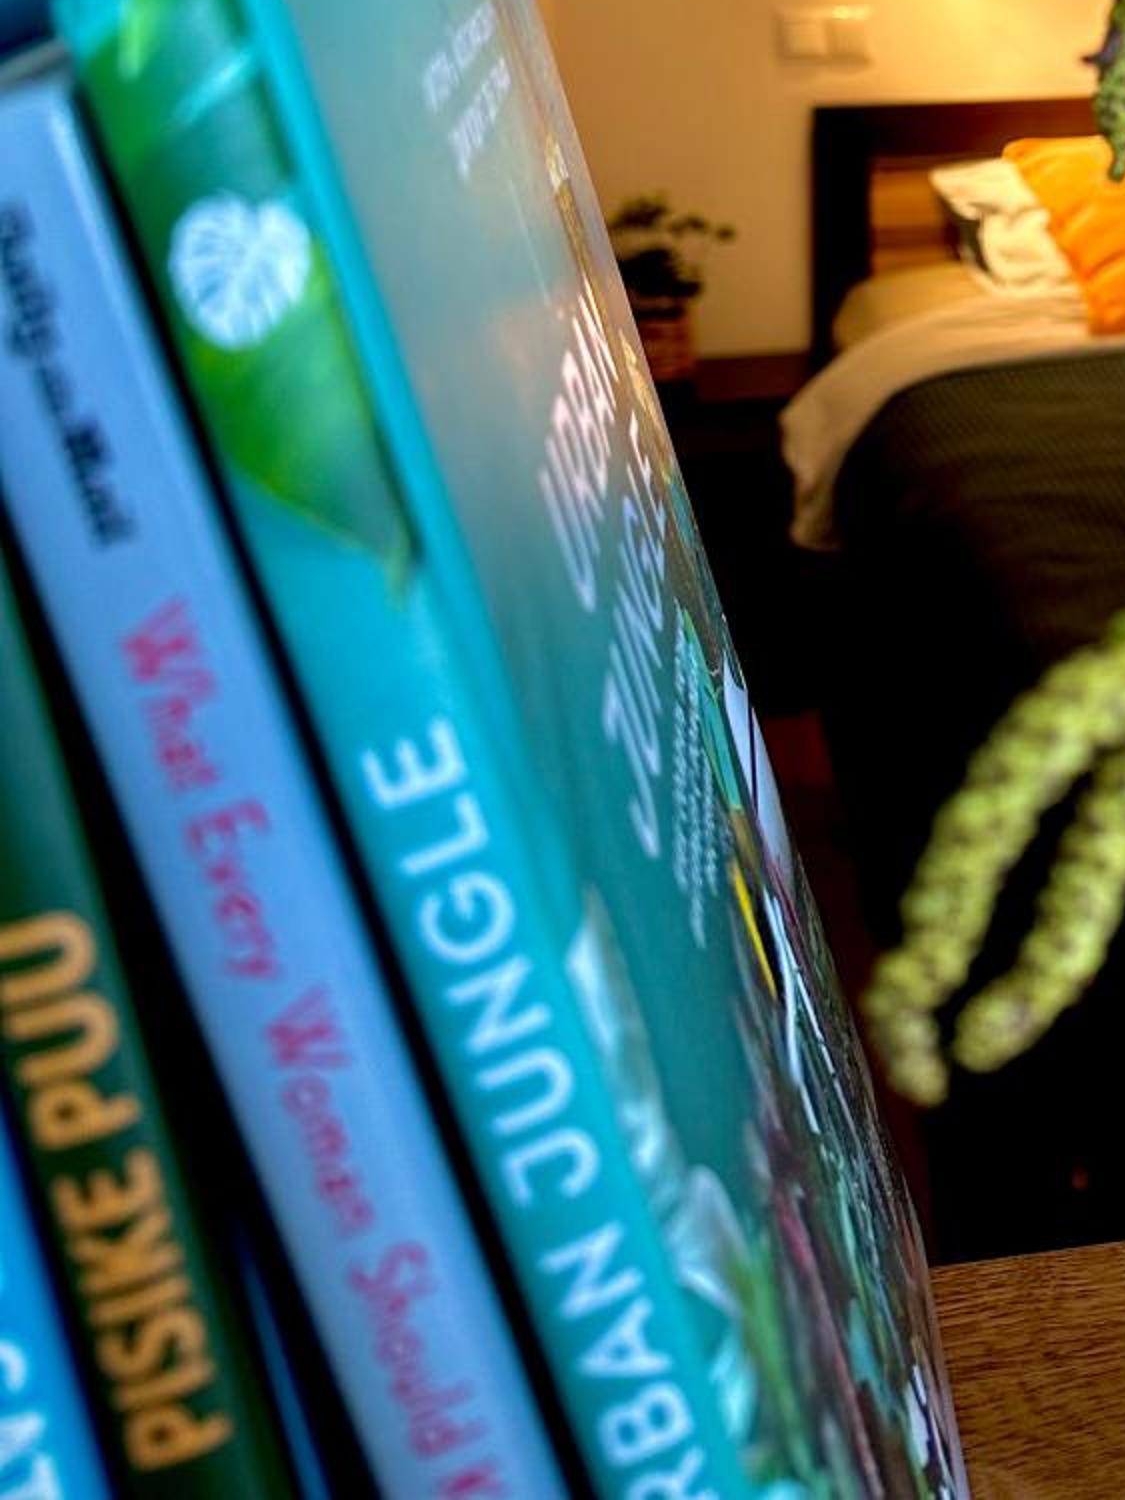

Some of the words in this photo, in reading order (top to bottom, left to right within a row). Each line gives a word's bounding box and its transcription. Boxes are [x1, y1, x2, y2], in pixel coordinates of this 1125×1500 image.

[540, 270, 620, 613] URBAN
[603, 410, 666, 860] JUNGLE
[0, 910, 140, 1150] PUU
[122, 593, 220, 795] What
[185, 798, 281, 980] Every
[267, 988, 377, 1238] Woman
[348, 1240, 489, 1462] Should
[362, 718, 600, 1207] JUNGLE
[50, 1148, 236, 1470] PISIKE
